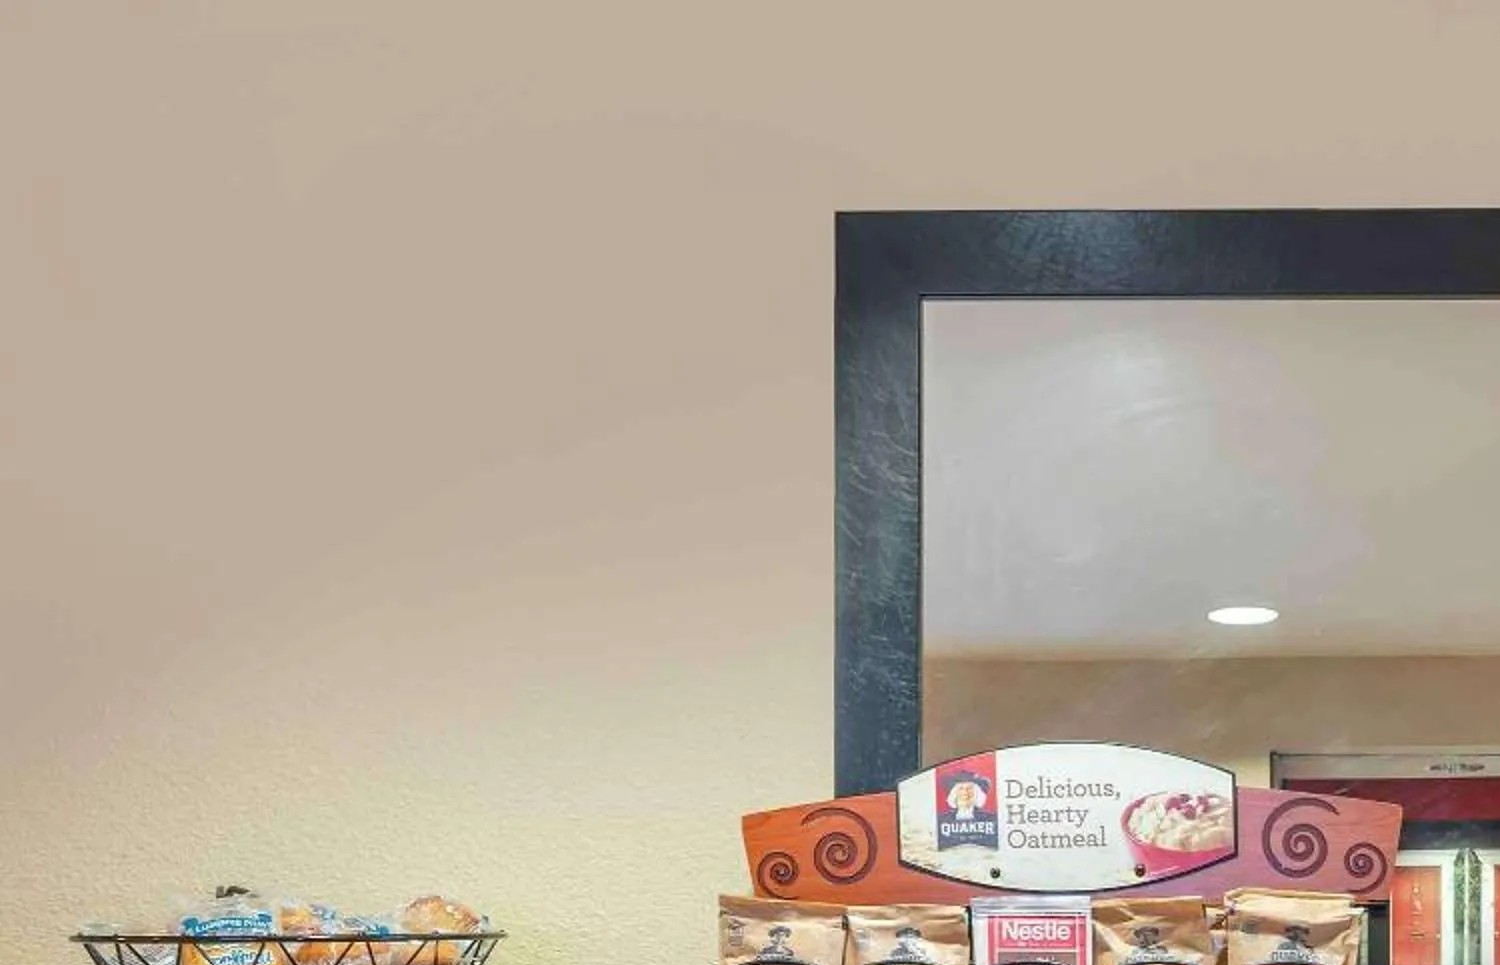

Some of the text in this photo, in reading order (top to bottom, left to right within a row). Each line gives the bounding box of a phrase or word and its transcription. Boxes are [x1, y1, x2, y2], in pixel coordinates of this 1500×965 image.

[1005, 777, 1121, 801] Delicious,
[1007, 804, 1090, 828] Hearty
[941, 822, 995, 836] QUAKER
[1007, 826, 1108, 850] Oatmeal
